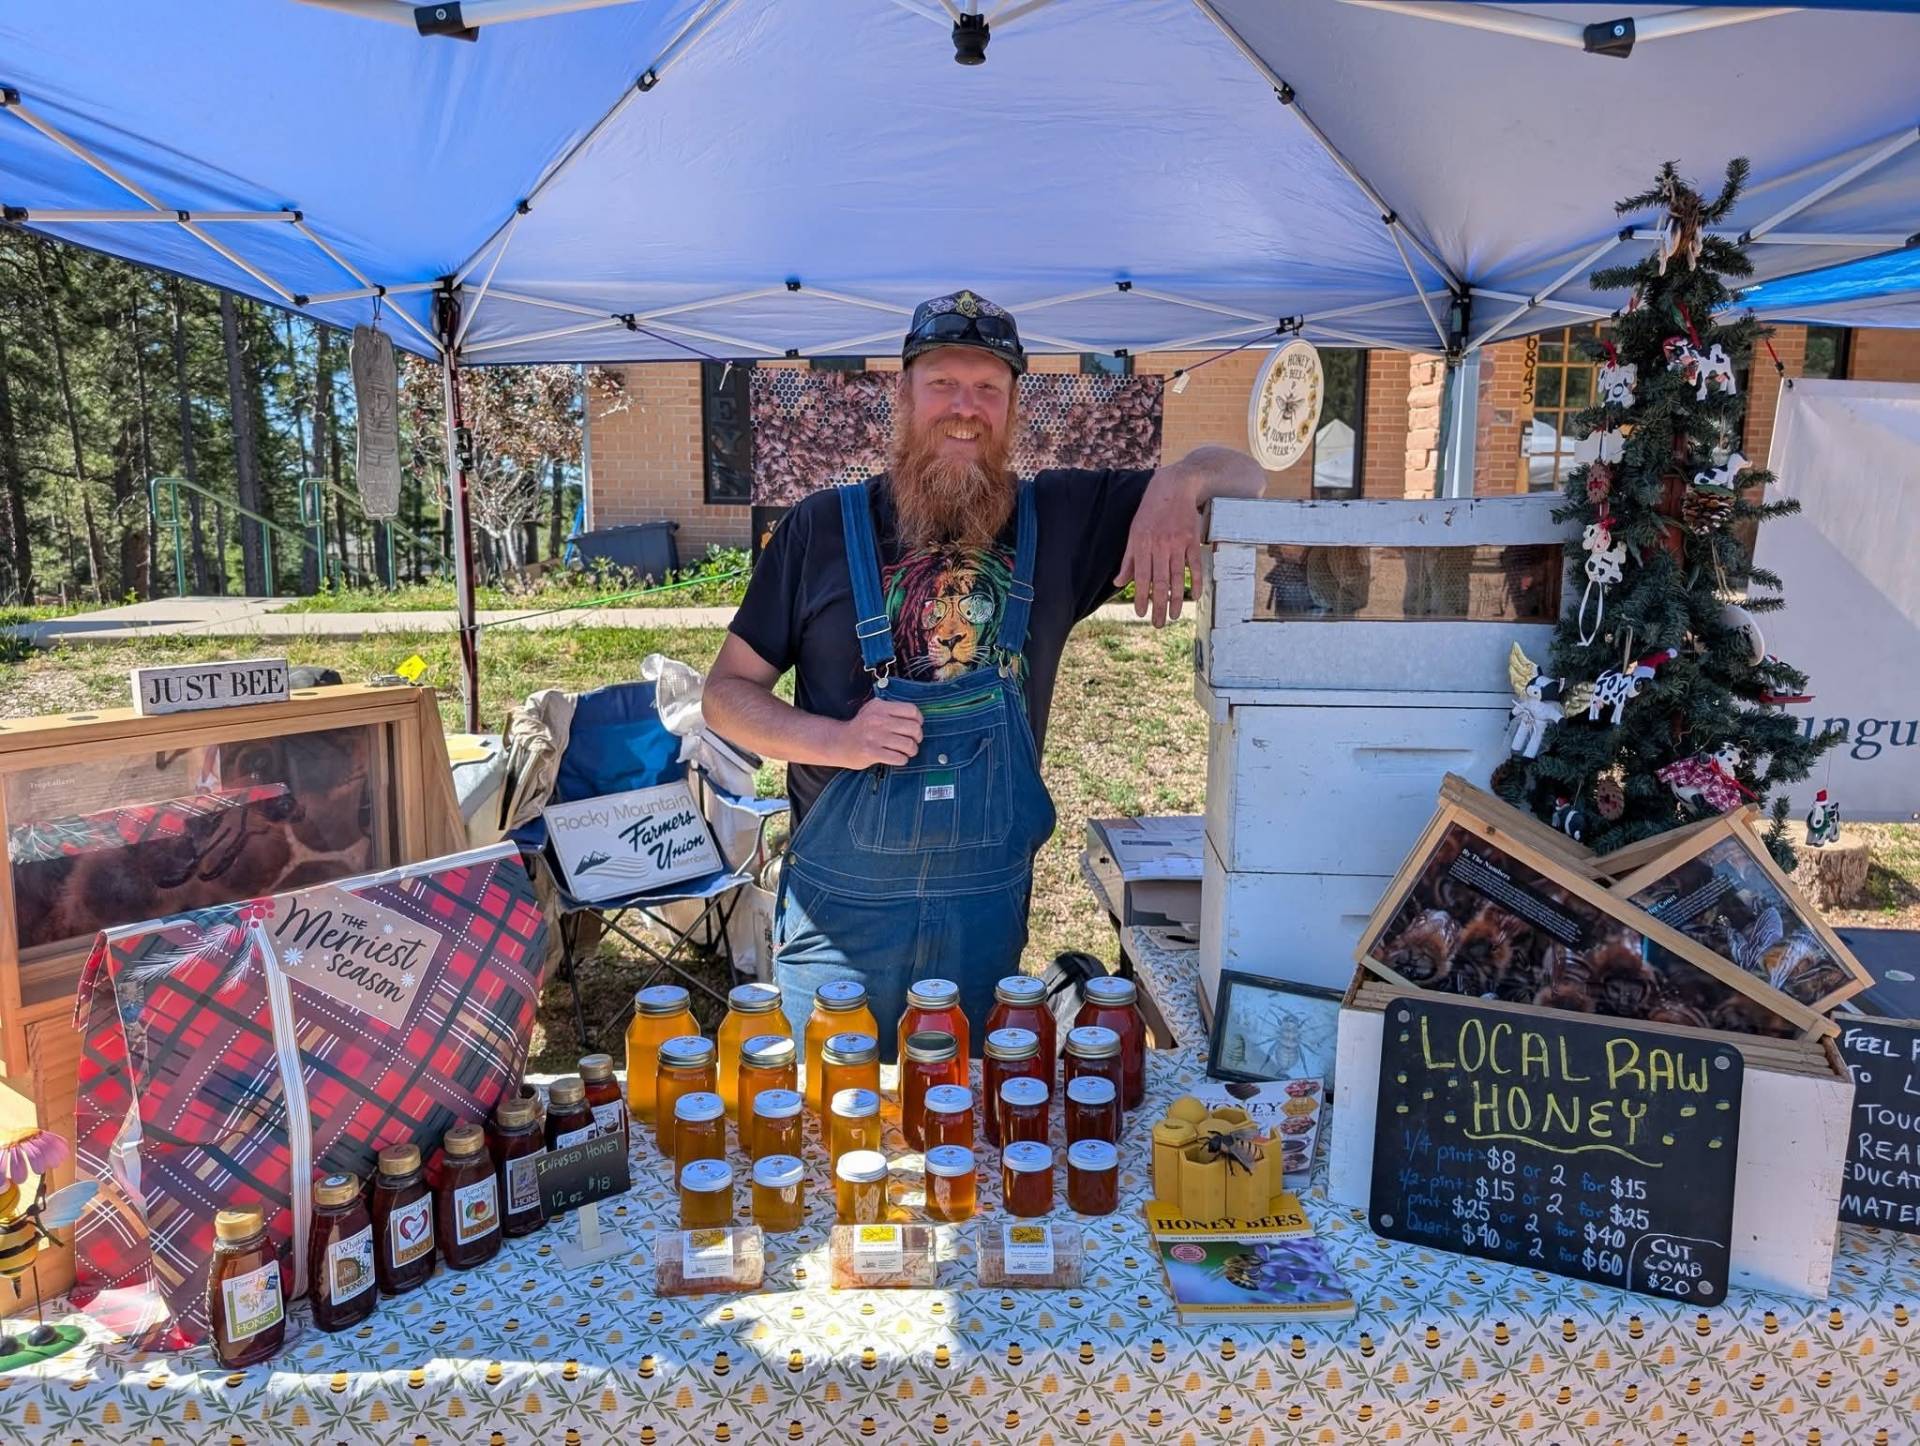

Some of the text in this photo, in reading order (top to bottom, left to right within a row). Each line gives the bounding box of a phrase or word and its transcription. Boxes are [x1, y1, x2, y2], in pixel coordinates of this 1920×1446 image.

[150, 667, 285, 704] JUST BEE
[553, 793, 692, 833] Rocky Mountain
[618, 809, 696, 852] Farmers
[647, 833, 706, 871] Union
[1472, 852, 1485, 865] The
[1485, 860, 1512, 881] Numbers
[274, 896, 427, 970] Merriest
[341, 912, 368, 930] THE
[326, 953, 406, 1002] season
[1421, 1015, 1708, 1093] LOCAL RAW
[1843, 1027, 1901, 1058] FEEL
[1473, 1080, 1648, 1145] HONEY
[537, 1138, 620, 1176] INFUSED HONEY
[1404, 1128, 1433, 1161] 1/4
[1487, 1145, 1516, 1175] $8
[1522, 1164, 1543, 1179] or
[1549, 1163, 1567, 1187] 2
[1580, 1171, 1605, 1193] for
[1609, 1175, 1647, 1201] $15
[513, 1193, 539, 1208] HONE
[551, 1190, 565, 1208] 12
[588, 1170, 612, 1193] $18
[1475, 1175, 1515, 1201] $15
[1522, 1193, 1542, 1207] or
[1546, 1193, 1564, 1216] 2
[1578, 1200, 1604, 1219] for
[1609, 1203, 1650, 1231] $25
[1156, 1213, 1304, 1231] HONEY BEES
[1452, 1194, 1491, 1222] $25
[1499, 1211, 1517, 1224] or
[1524, 1213, 1541, 1234] 2
[1556, 1219, 1577, 1238] for
[1583, 1221, 1626, 1249] $40
[1461, 1222, 1501, 1249] $40
[1504, 1238, 1521, 1252] or
[1528, 1237, 1545, 1260] 2
[1558, 1246, 1579, 1263] for
[1581, 1247, 1624, 1276] $60
[1643, 1254, 1703, 1278] COMB
[1650, 1239, 1693, 1261] CUT
[1647, 1271, 1691, 1295] $20
[235, 1307, 279, 1334] HONEY
